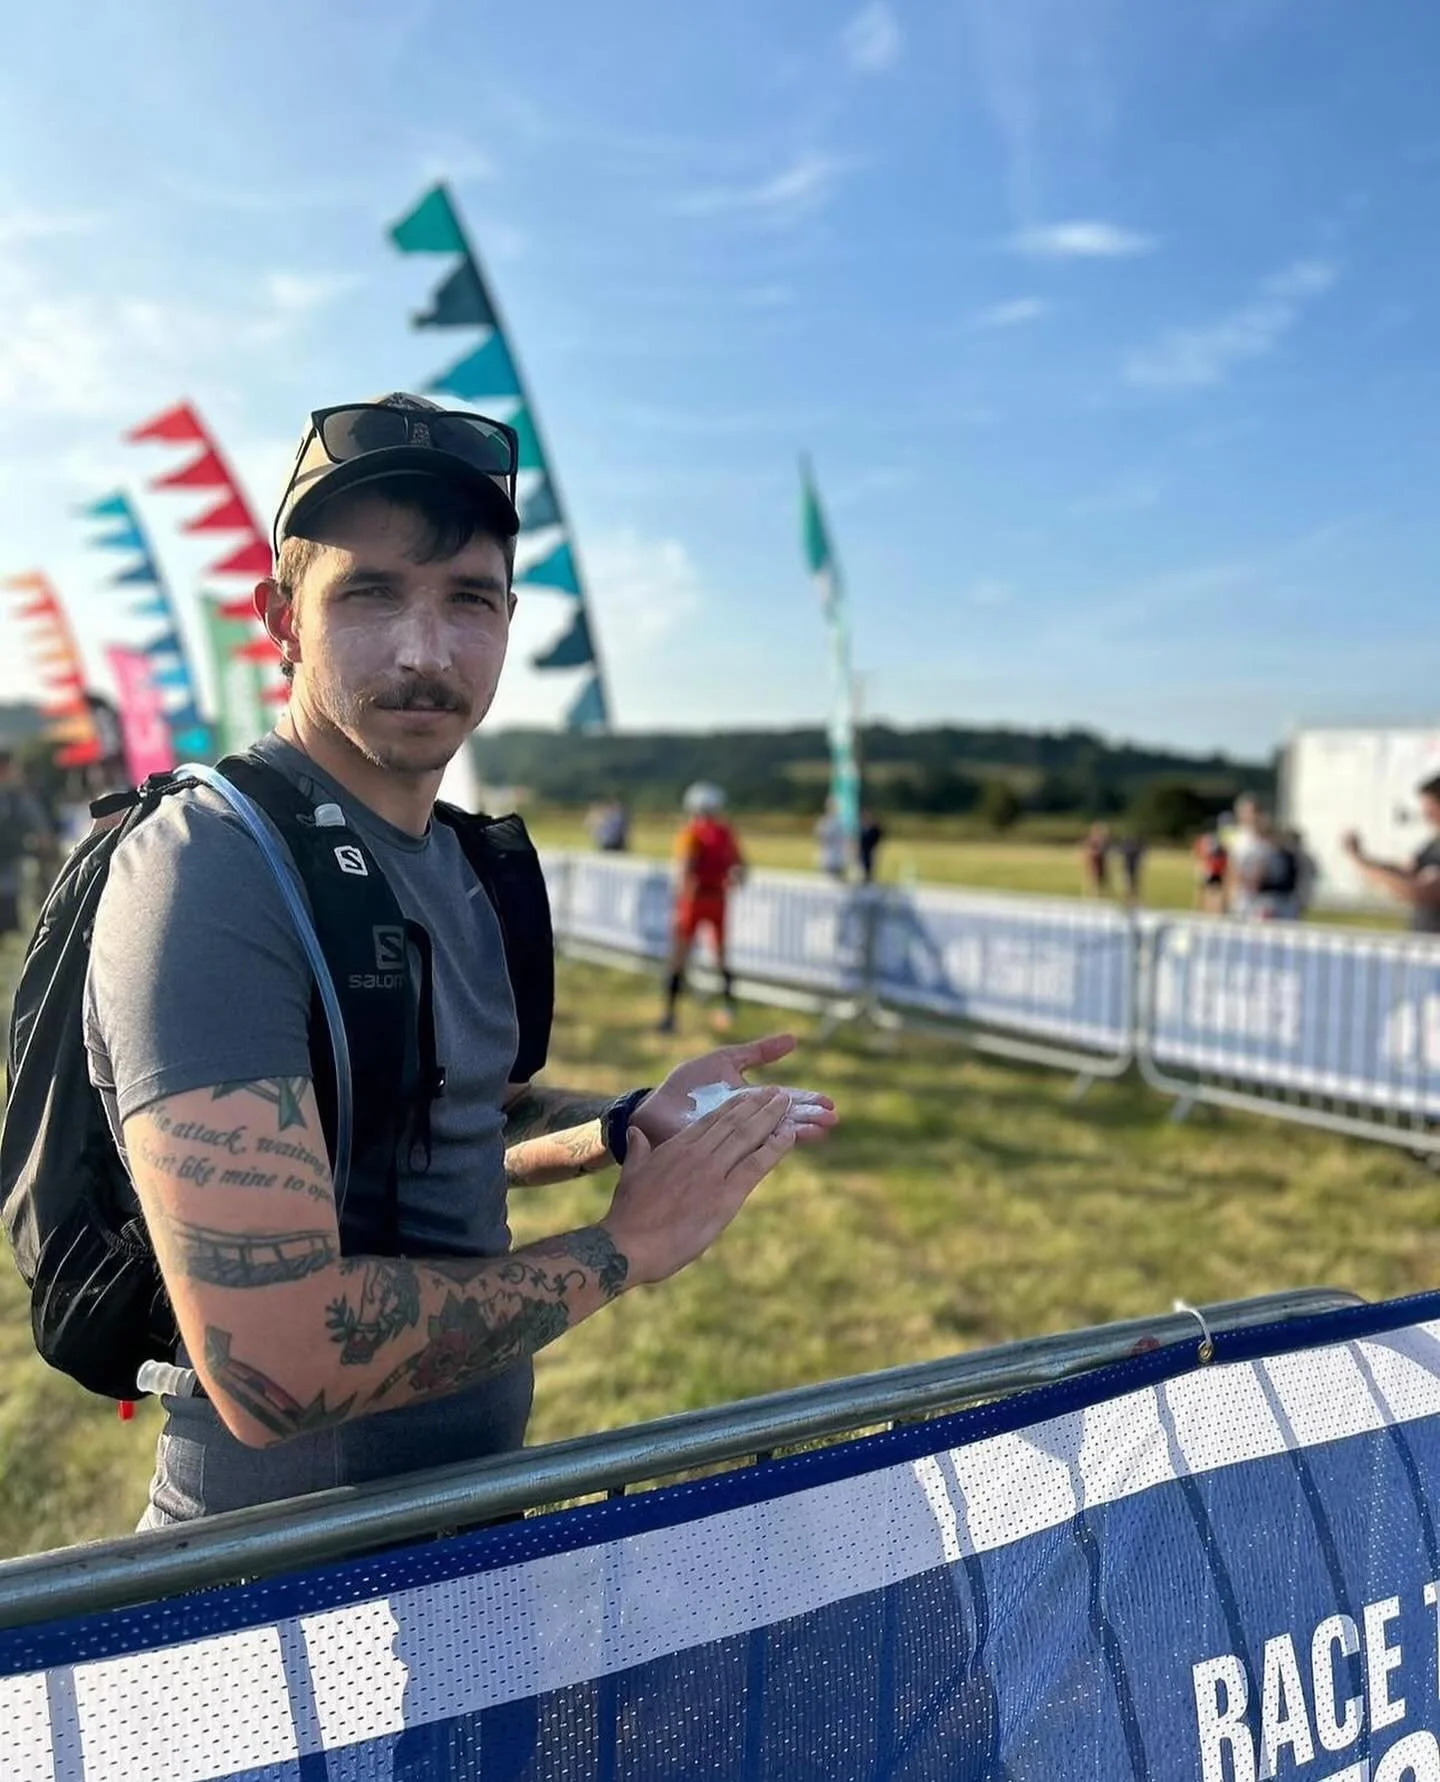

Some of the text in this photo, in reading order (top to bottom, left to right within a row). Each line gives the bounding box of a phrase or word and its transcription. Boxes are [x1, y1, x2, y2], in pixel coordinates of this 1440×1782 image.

[171, 1123, 248, 1155] attack,
[256, 1136, 327, 1177] waiting
[178, 1155, 216, 1187] like
[219, 1166, 278, 1188] mine
[282, 1174, 306, 1192] to
[1192, 1595, 1407, 1782] RACE
